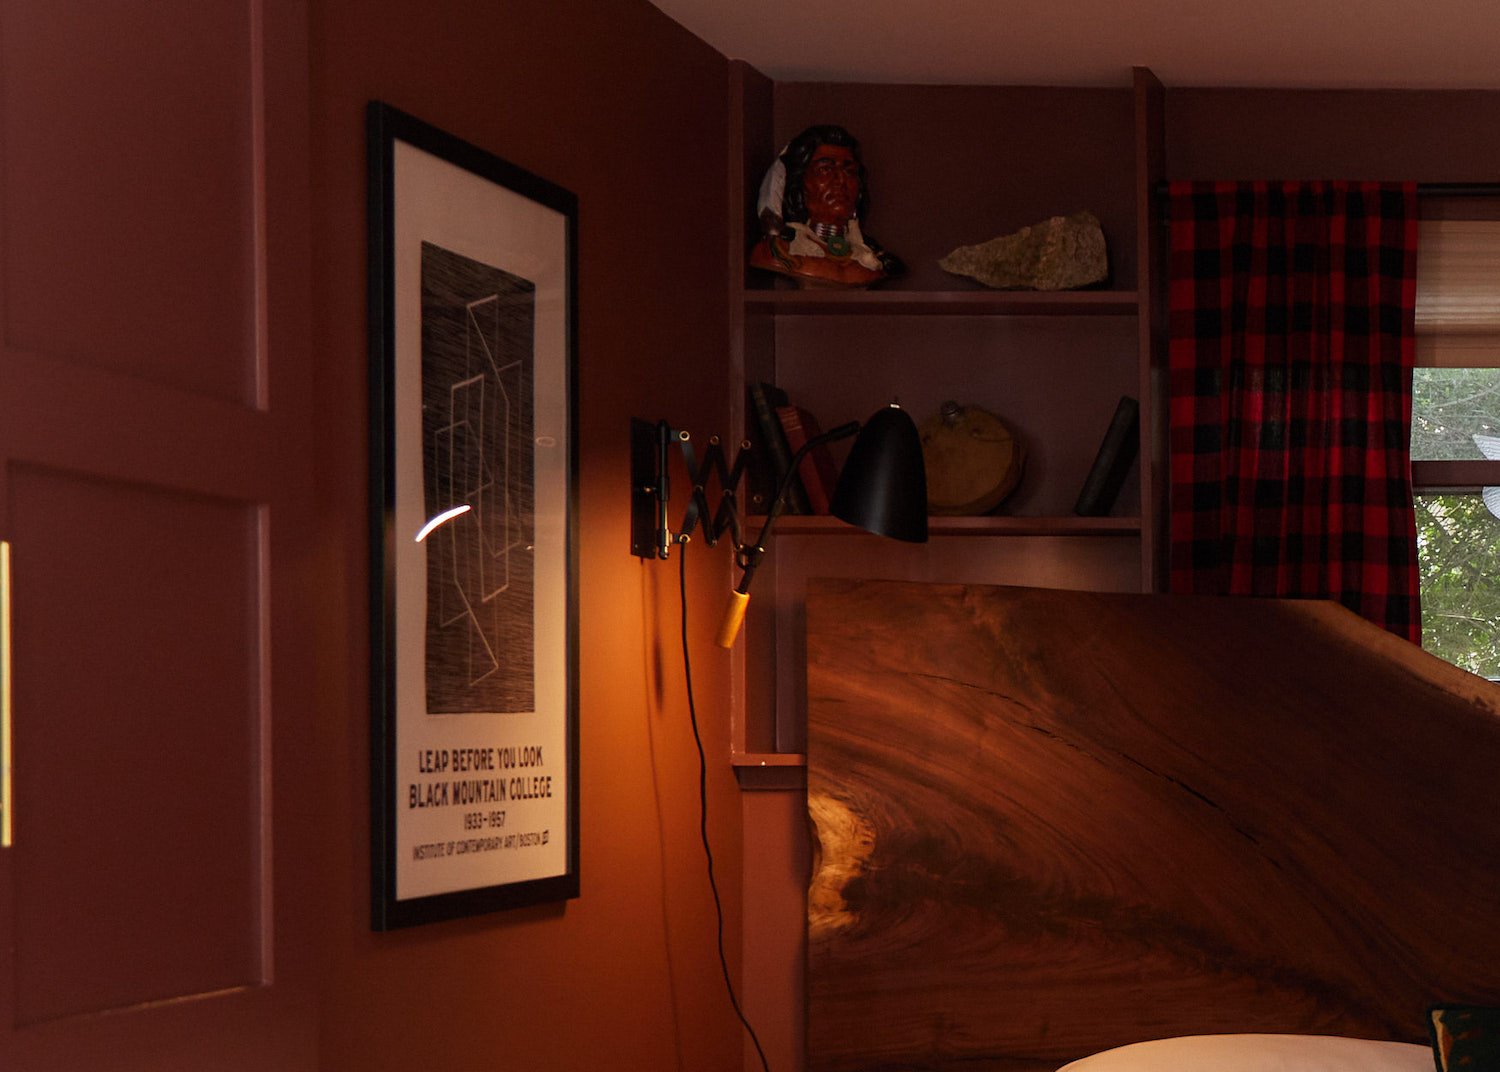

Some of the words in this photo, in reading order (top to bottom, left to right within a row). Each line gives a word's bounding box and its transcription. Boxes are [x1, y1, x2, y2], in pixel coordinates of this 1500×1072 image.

[419, 750, 449, 773] LEAP
[452, 748, 495, 772] BEFORE
[497, 747, 516, 769] YOU
[518, 746, 544, 767] LOOK
[409, 782, 448, 809] BLACK
[452, 778, 506, 805] MOUNTAIN
[510, 776, 552, 800] COLLEGE
[464, 811, 506, 830] 1933-1957
